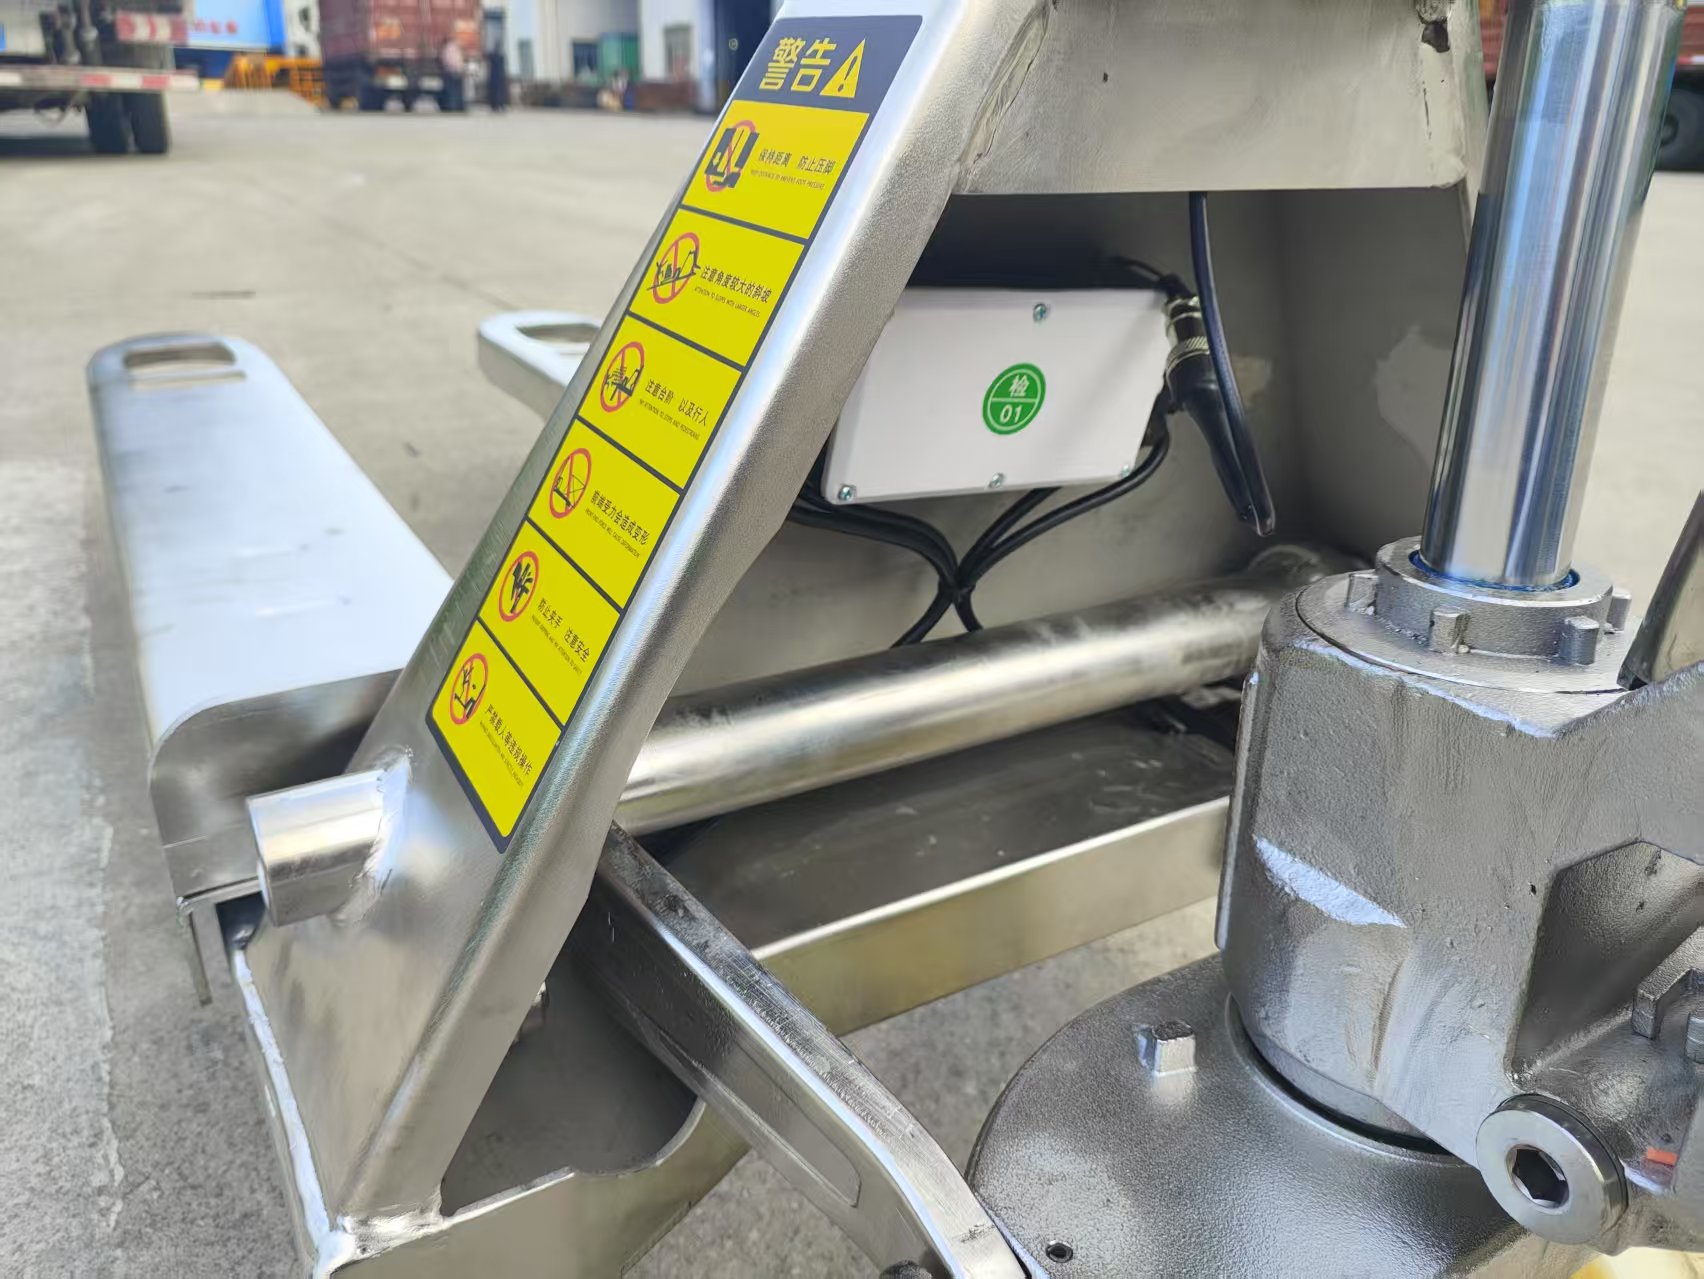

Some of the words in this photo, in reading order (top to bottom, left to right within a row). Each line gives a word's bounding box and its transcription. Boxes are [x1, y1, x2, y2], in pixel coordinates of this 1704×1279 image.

[759, 37, 837, 93] 警告
[700, 265, 772, 303] 注意角度较大的斜坡
[645, 379, 674, 405] 注意台阶
[678, 398, 709, 427] 以及行人
[1009, 375, 1030, 397] 检
[1000, 404, 1022, 424] 01
[590, 490, 650, 545] 前端受力会造成变形
[538, 597, 563, 629] 防止夹手
[564, 627, 590, 663] 注意安全
[485, 703, 533, 776] 严禁载人等违规操作
